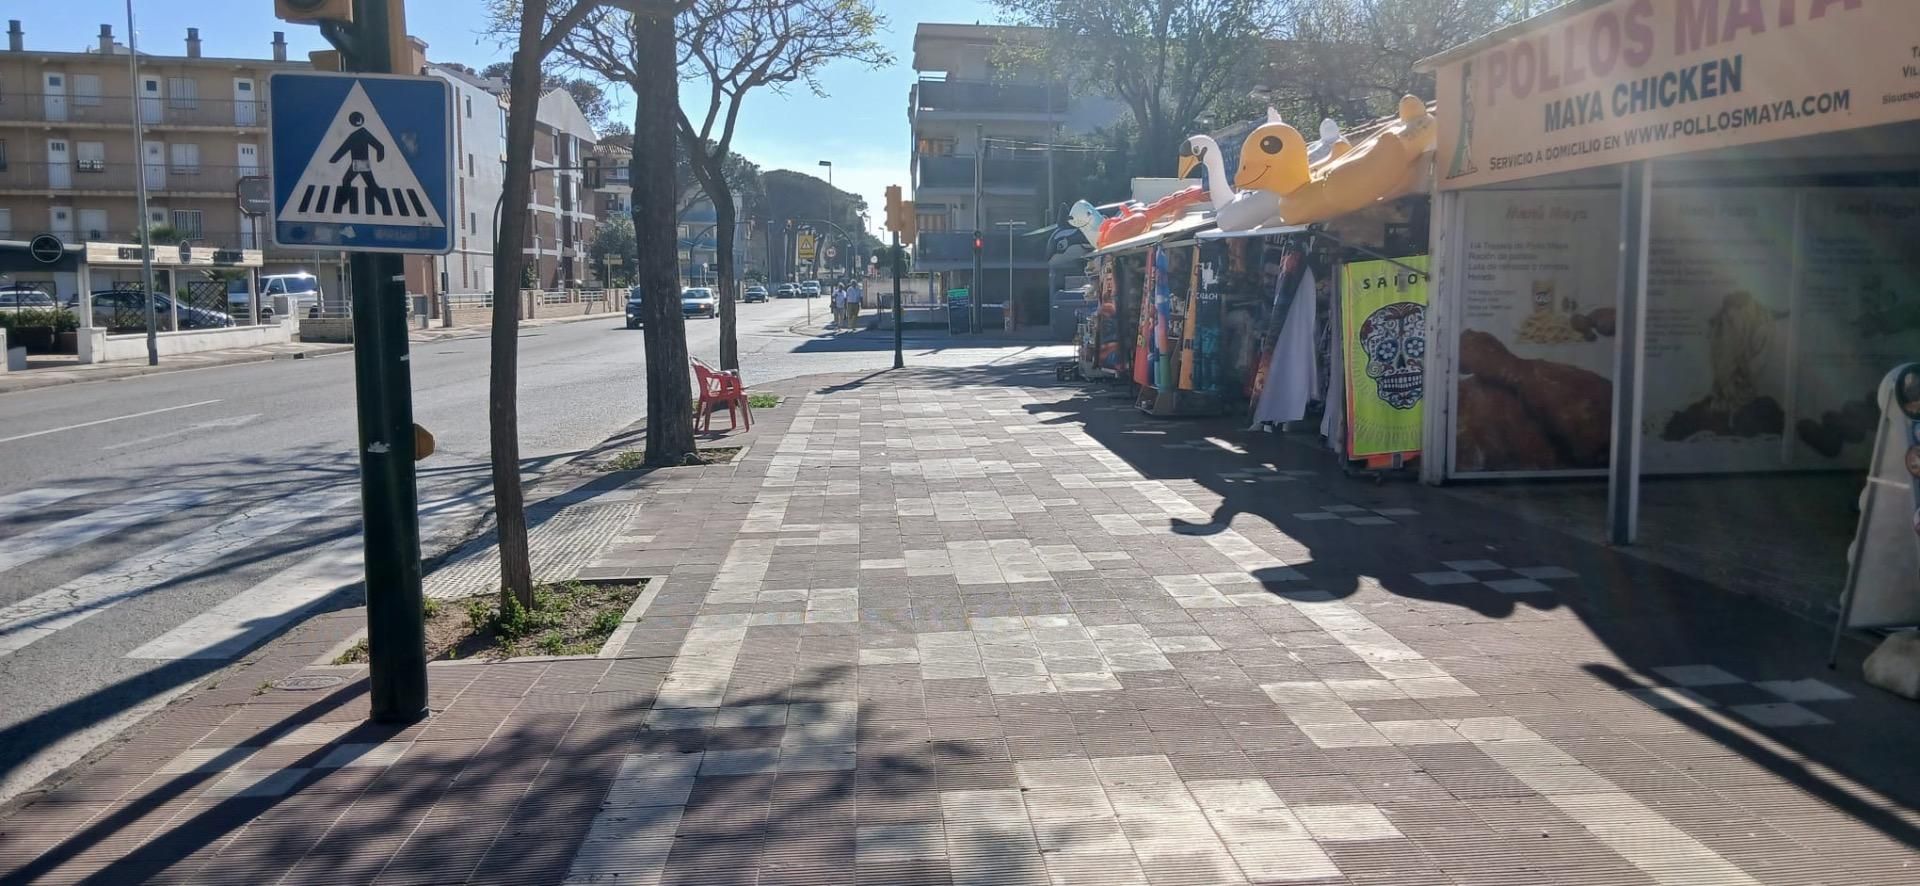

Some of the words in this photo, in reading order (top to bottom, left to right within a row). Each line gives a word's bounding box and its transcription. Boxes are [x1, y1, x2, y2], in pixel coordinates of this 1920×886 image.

[1487, 1, 1655, 106] POLLOS
[1911, 45, 1920, 59] T
[1535, 152, 1544, 164] A
[1604, 135, 1620, 151] EN
[1624, 88, 1850, 147] WWW.POLLOSMAYA.COM
[1544, 91, 1604, 133] MAYA
[1612, 53, 1743, 118] CHICKEN
